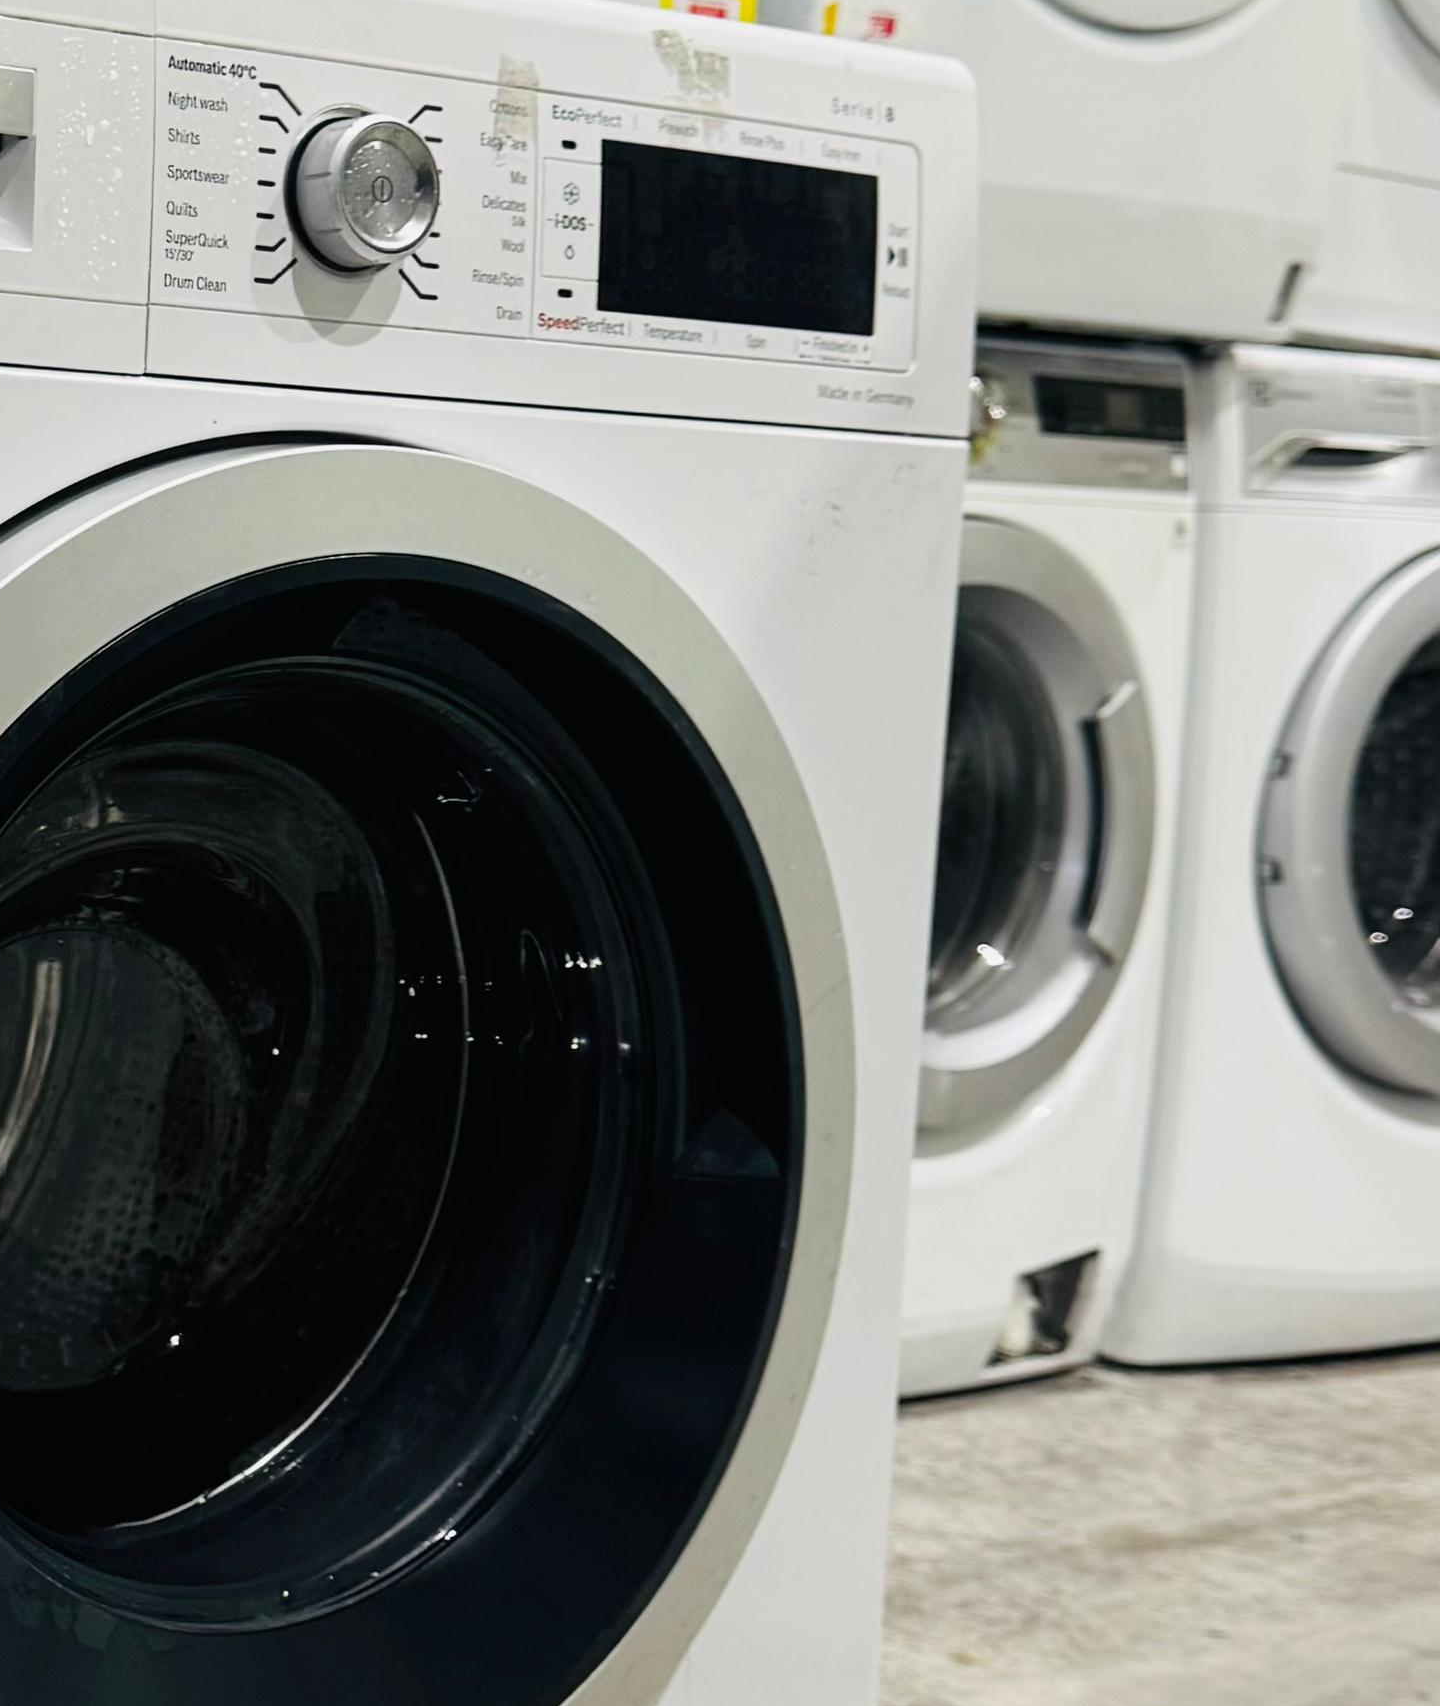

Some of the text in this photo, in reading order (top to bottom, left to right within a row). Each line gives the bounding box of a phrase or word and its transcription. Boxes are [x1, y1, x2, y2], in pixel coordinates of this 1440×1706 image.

[168, 55, 257, 80] Automatic 40°C
[168, 91, 228, 113] Night wash
[552, 103, 623, 130] EcoPerfect
[167, 128, 201, 146] Shirts
[167, 164, 231, 186] Sportswear
[165, 199, 199, 219] Quilts
[481, 194, 527, 214] Delicates
[554, 212, 588, 233] i-DOS
[165, 229, 229, 251] SuperQuick
[163, 272, 228, 294] Drum Clean
[537, 311, 626, 338] SpeedPerfect
